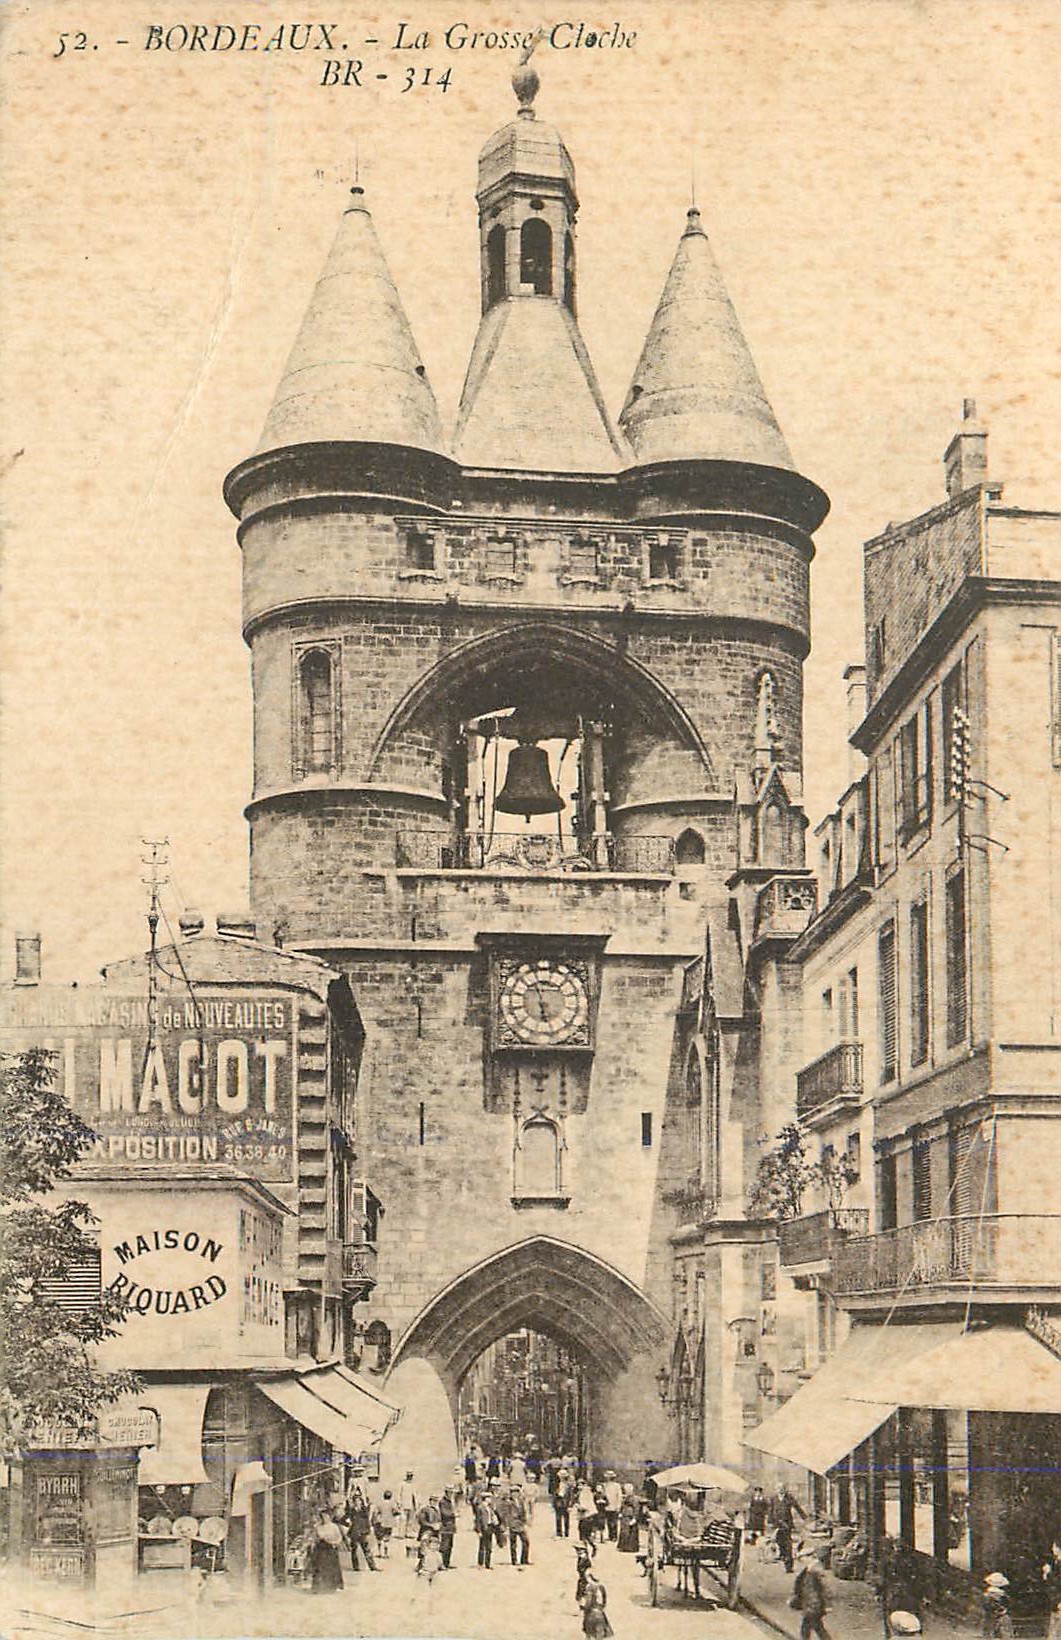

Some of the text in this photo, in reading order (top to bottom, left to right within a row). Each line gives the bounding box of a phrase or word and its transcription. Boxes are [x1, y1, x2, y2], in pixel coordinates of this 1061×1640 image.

[163, 1005, 181, 1028] de
[100, 1038, 287, 1115] MAGOT
[113, 1230, 223, 1265] MAISON
[105, 1272, 227, 1316] RIQUARD
[39, 1476, 77, 1495] BYRRH
